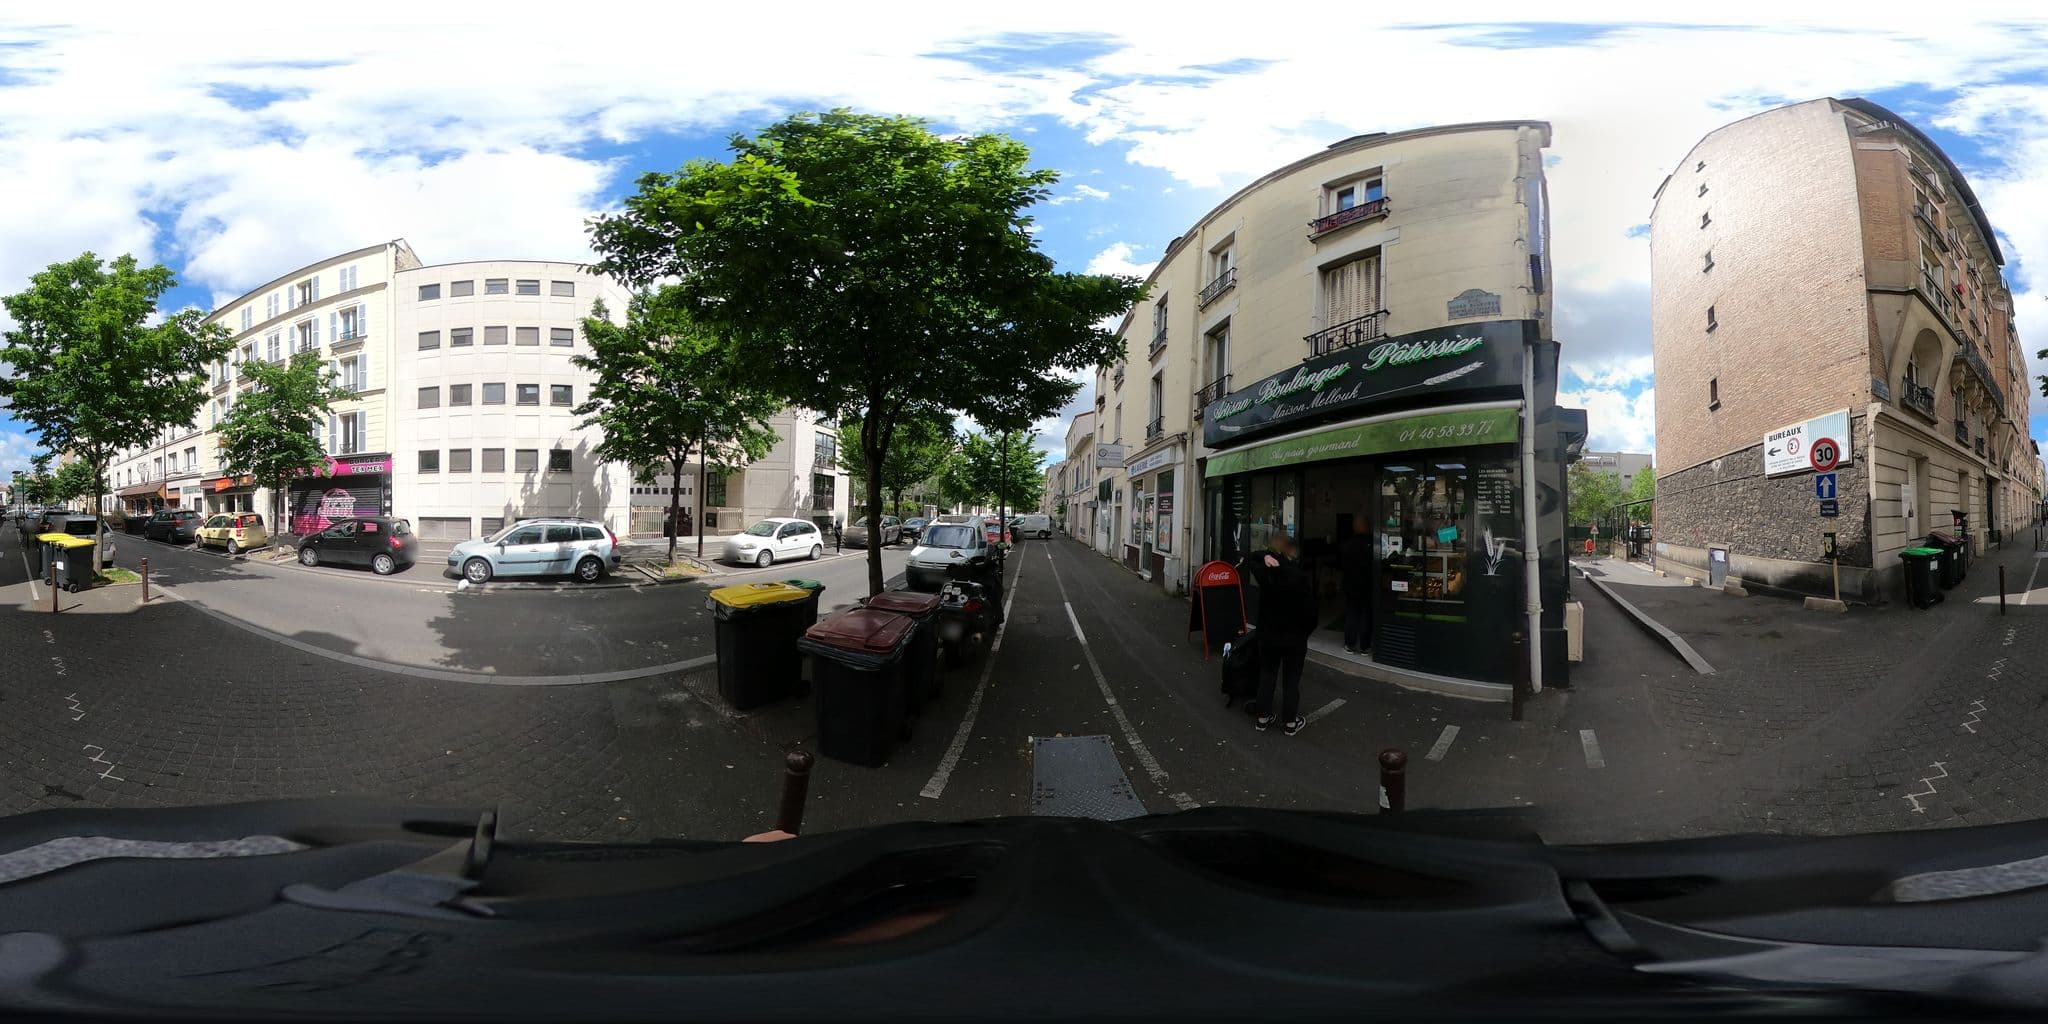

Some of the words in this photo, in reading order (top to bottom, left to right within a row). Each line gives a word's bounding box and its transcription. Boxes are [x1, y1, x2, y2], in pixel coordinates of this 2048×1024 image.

[1255, 361, 1351, 404] Boulanger
[1362, 335, 1484, 371] Pâtissier
[1269, 401, 1305, 420] Maison
[1400, 428, 1416, 442] 01
[1419, 427, 1436, 439] 46
[1437, 425, 1455, 438] 58
[1457, 423, 1474, 436] 33
[1769, 426, 1802, 442] BUREAUX
[1307, 433, 1361, 458] gourmand
[1816, 447, 1833, 462] 30
